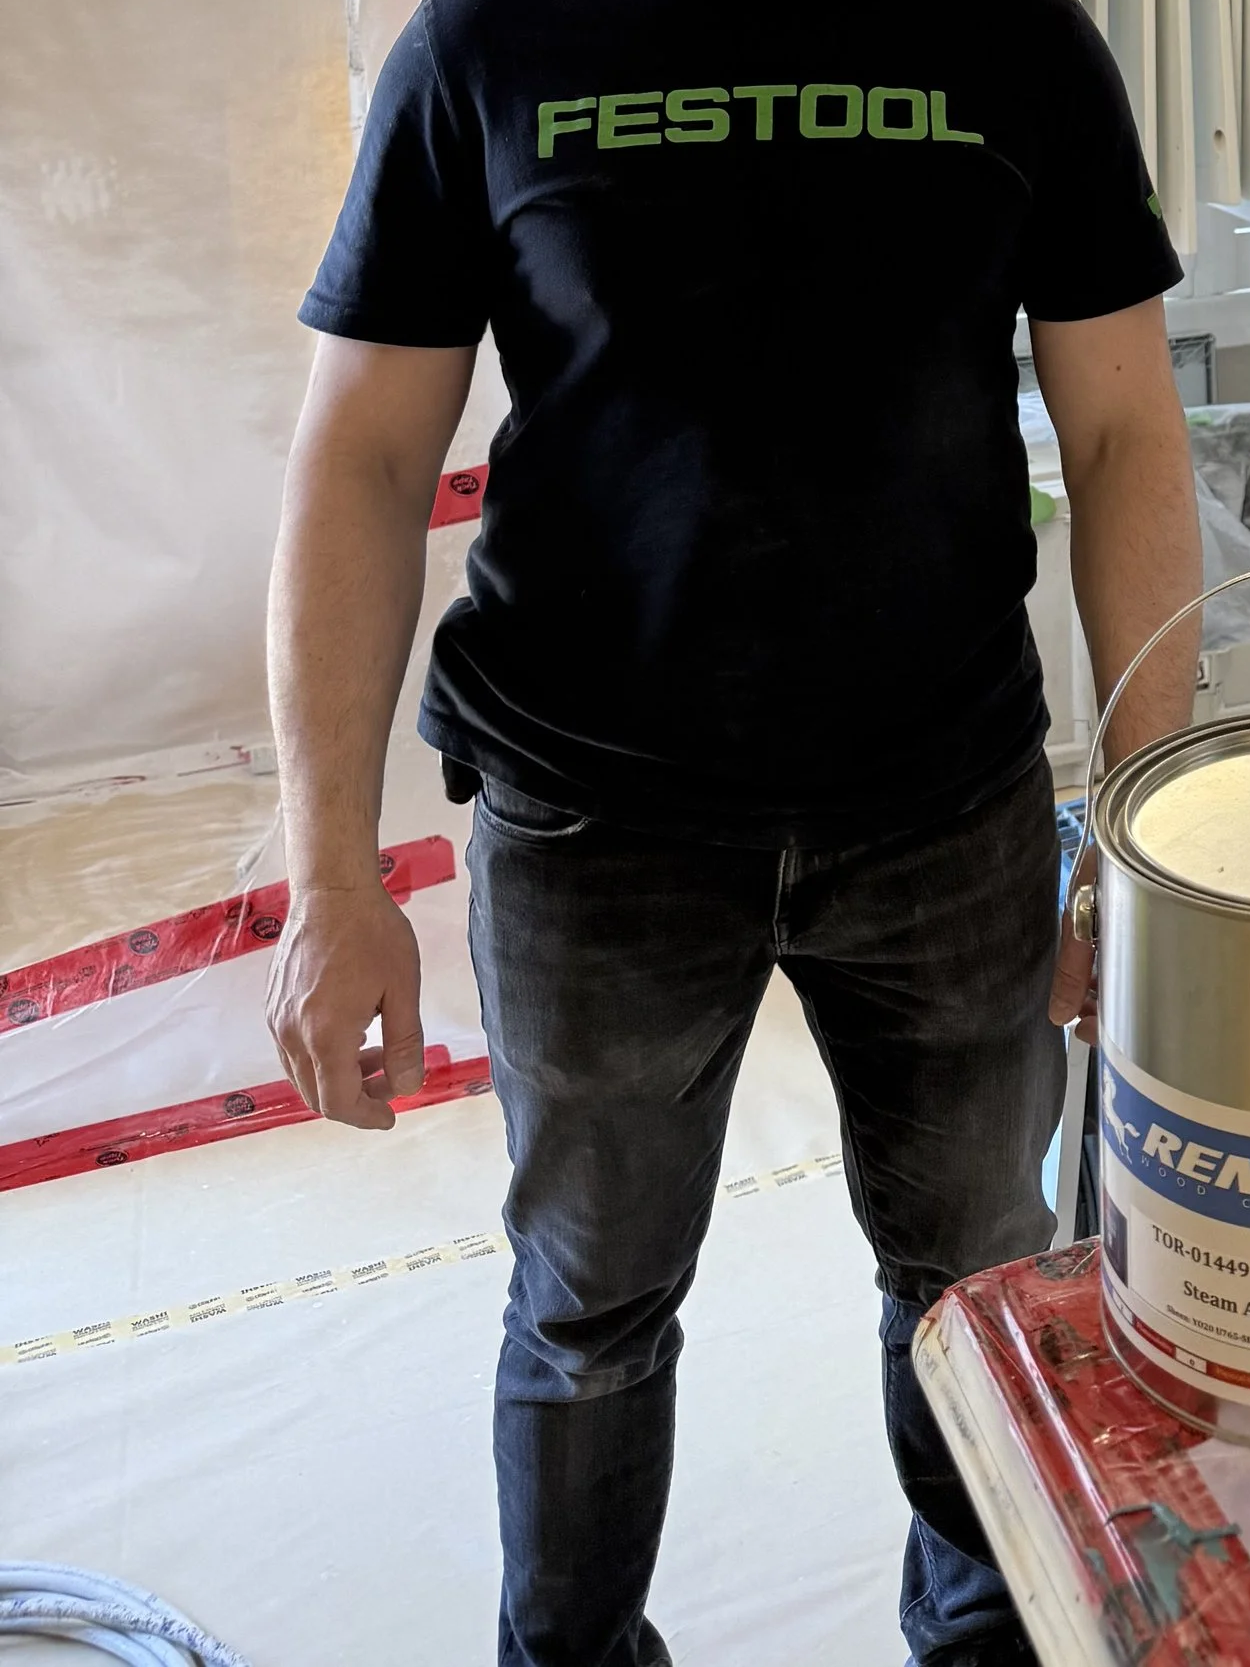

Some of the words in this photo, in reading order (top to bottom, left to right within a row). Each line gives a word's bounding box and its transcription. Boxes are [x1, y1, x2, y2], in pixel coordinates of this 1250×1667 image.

[537, 84, 984, 159] FESTOOL
[1140, 1154, 1206, 1196] WOOD
[1152, 1224, 1250, 1277] TOR-01449
[1183, 1280, 1238, 1314] Steam
